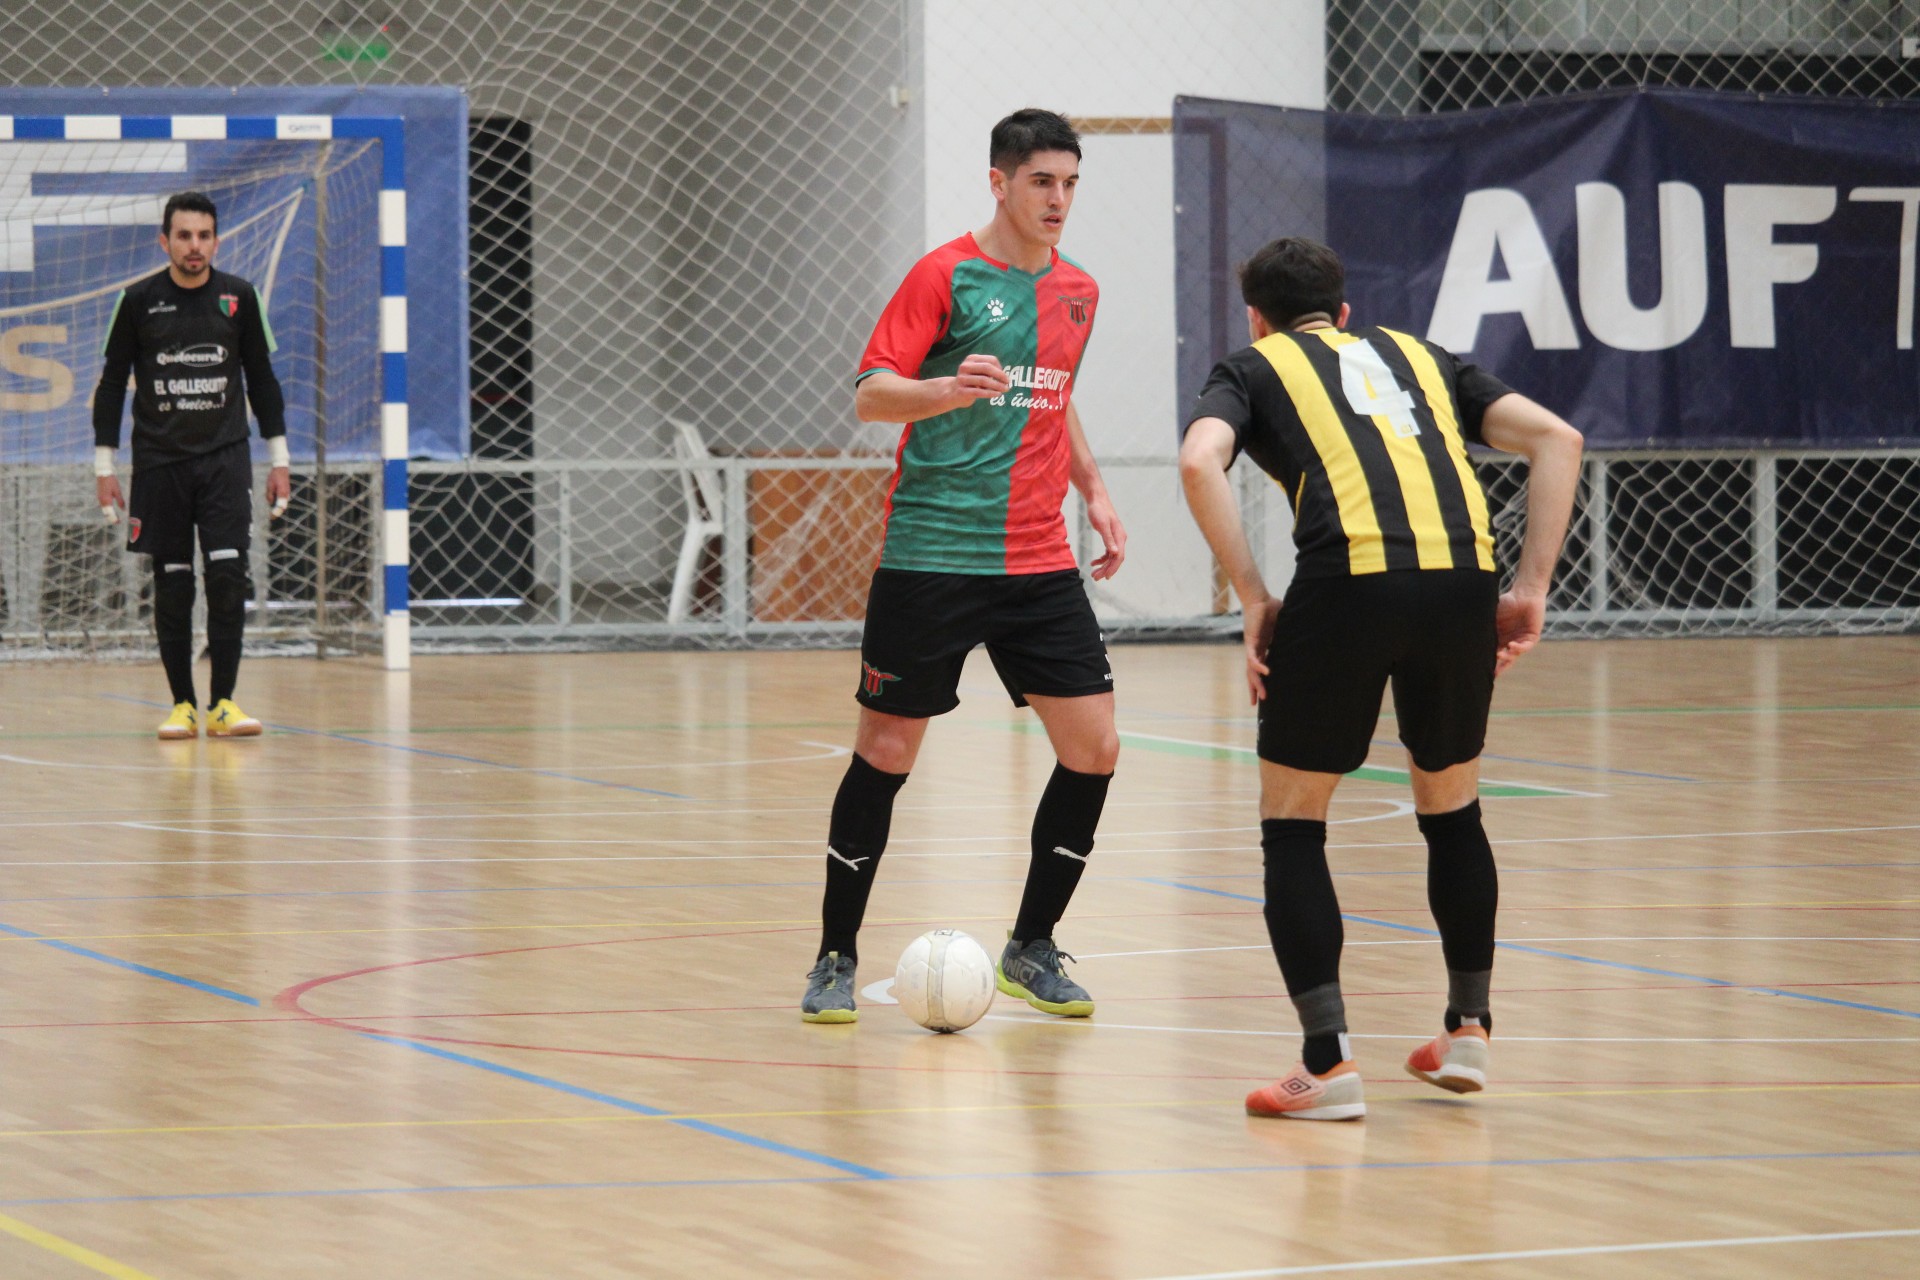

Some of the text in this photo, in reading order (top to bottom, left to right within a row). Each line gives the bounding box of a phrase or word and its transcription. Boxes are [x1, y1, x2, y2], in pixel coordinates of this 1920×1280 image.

[154, 378, 167, 395] EL
[1335, 338, 1421, 438] 4
[990, 394, 1005, 406] es
